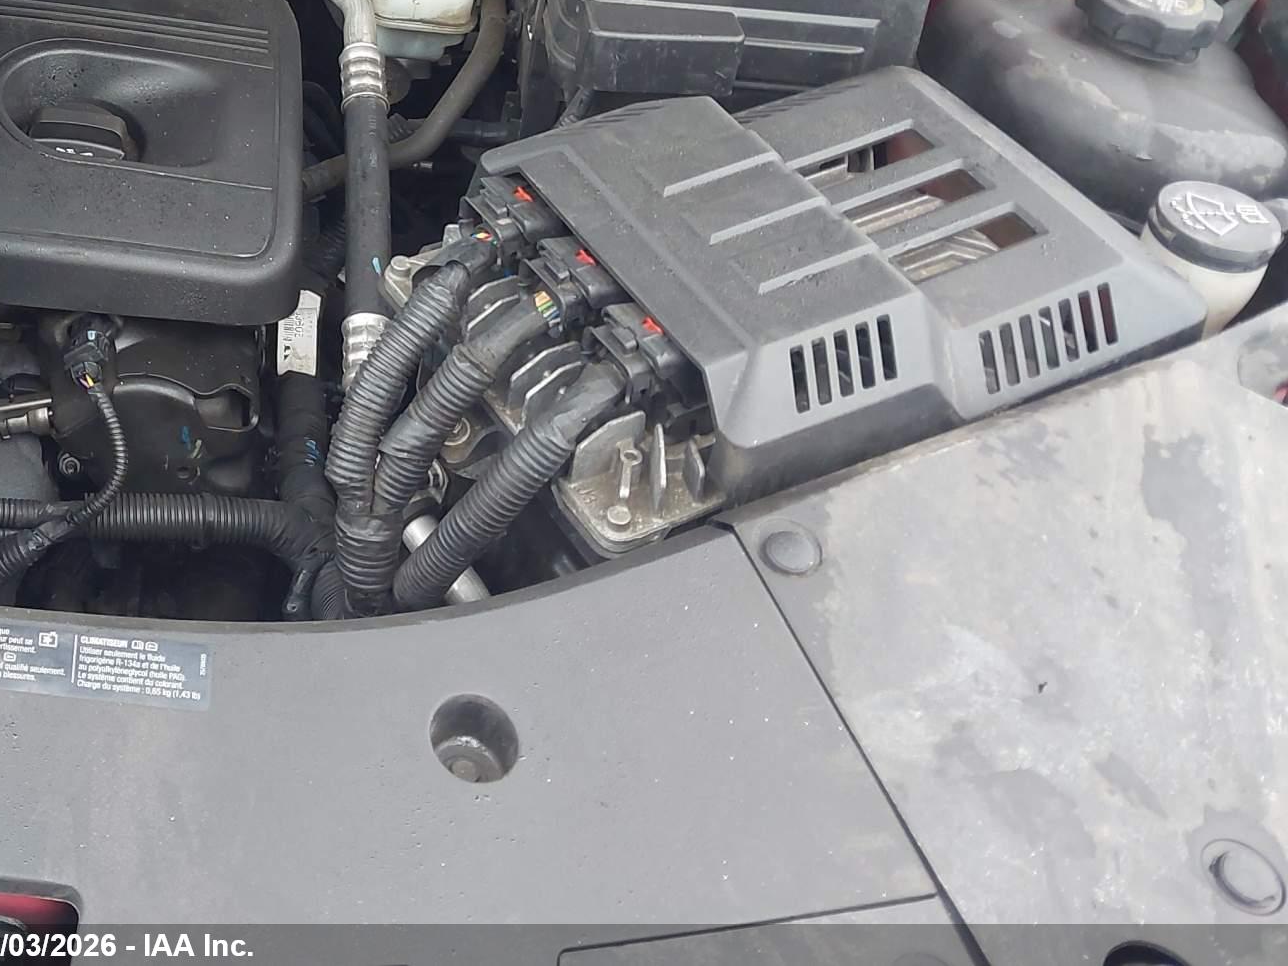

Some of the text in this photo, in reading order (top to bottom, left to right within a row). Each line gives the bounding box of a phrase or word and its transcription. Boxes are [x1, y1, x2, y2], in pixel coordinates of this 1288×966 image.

[9, 637, 24, 646] peut
[81, 636, 128, 648] CLIMATISEUR
[80, 647, 103, 656] Utiliser
[104, 649, 138, 659] seulement
[147, 654, 166, 663] fluide
[4, 662, 29, 673] qualifié
[79, 655, 114, 666] frigorigène
[116, 660, 140, 668] R-134a
[160, 664, 180, 672] l'huile
[88, 673, 115, 683] système
[117, 676, 144, 685] contient
[77, 680, 101, 690] Charge
[112, 684, 140, 695] système
[163, 689, 171, 698] kg
